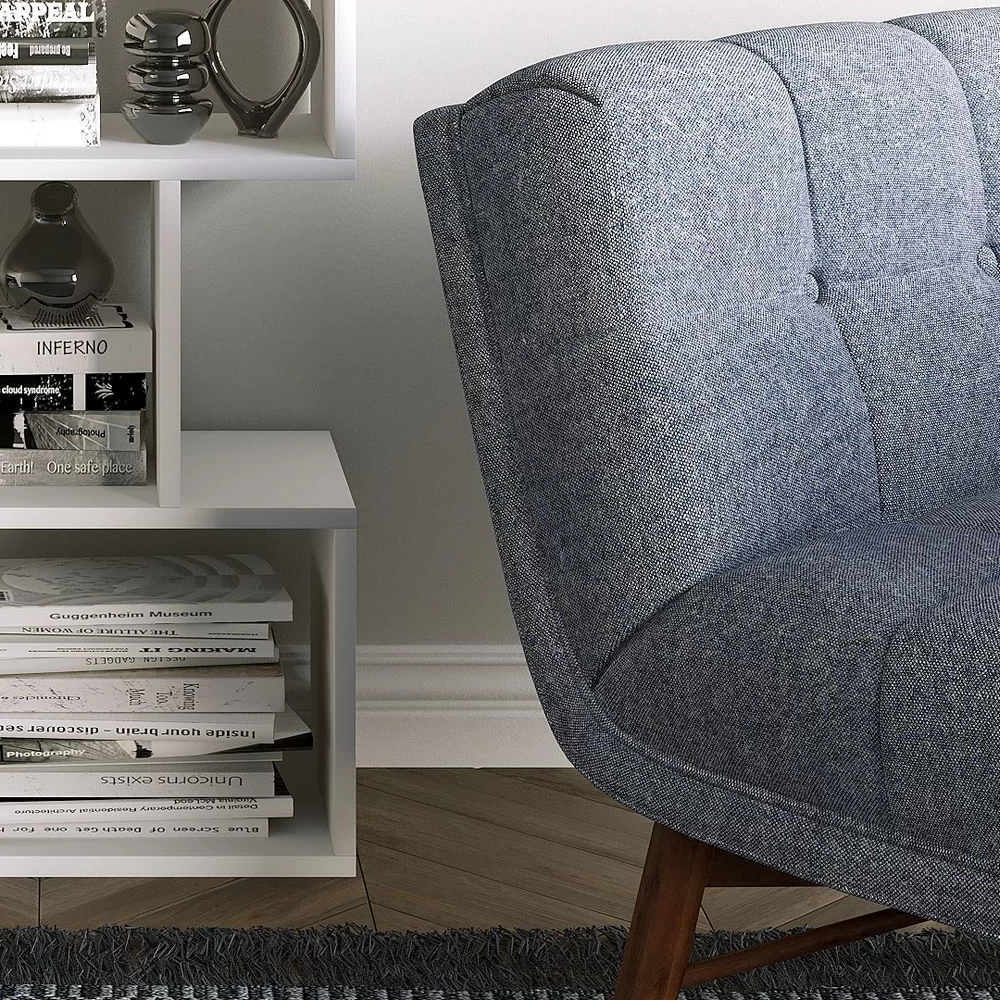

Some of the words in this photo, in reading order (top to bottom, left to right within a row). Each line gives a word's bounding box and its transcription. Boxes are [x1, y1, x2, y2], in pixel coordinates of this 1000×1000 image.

[29, 44, 61, 57] prepared
[37, 339, 108, 356] INFERNO
[2, 385, 23, 395] cloud
[23, 385, 60, 397] syndrome
[56, 428, 106, 438] Photography
[1, 461, 34, 474] Earth!
[46, 461, 72, 474] One
[75, 461, 99, 474] safe
[103, 461, 133, 478] place
[49, 611, 144, 620] Guggenheim
[149, 610, 213, 618] Museum
[22, 626, 73, 634] WOMEN
[98, 627, 148, 635] ALLURE
[85, 656, 135, 665] GADGETS
[128, 688, 145, 707] Much
[156, 691, 173, 705] Too
[178, 683, 200, 710] Knowing
[27, 724, 100, 735] discover
[116, 726, 158, 737] brain
[161, 729, 201, 737] your
[205, 730, 256, 739] Inside
[6, 748, 86, 758] Photography
[100, 775, 152, 785] exists
[158, 775, 243, 786] Unicorns
[140, 804, 213, 813] Contemporary
